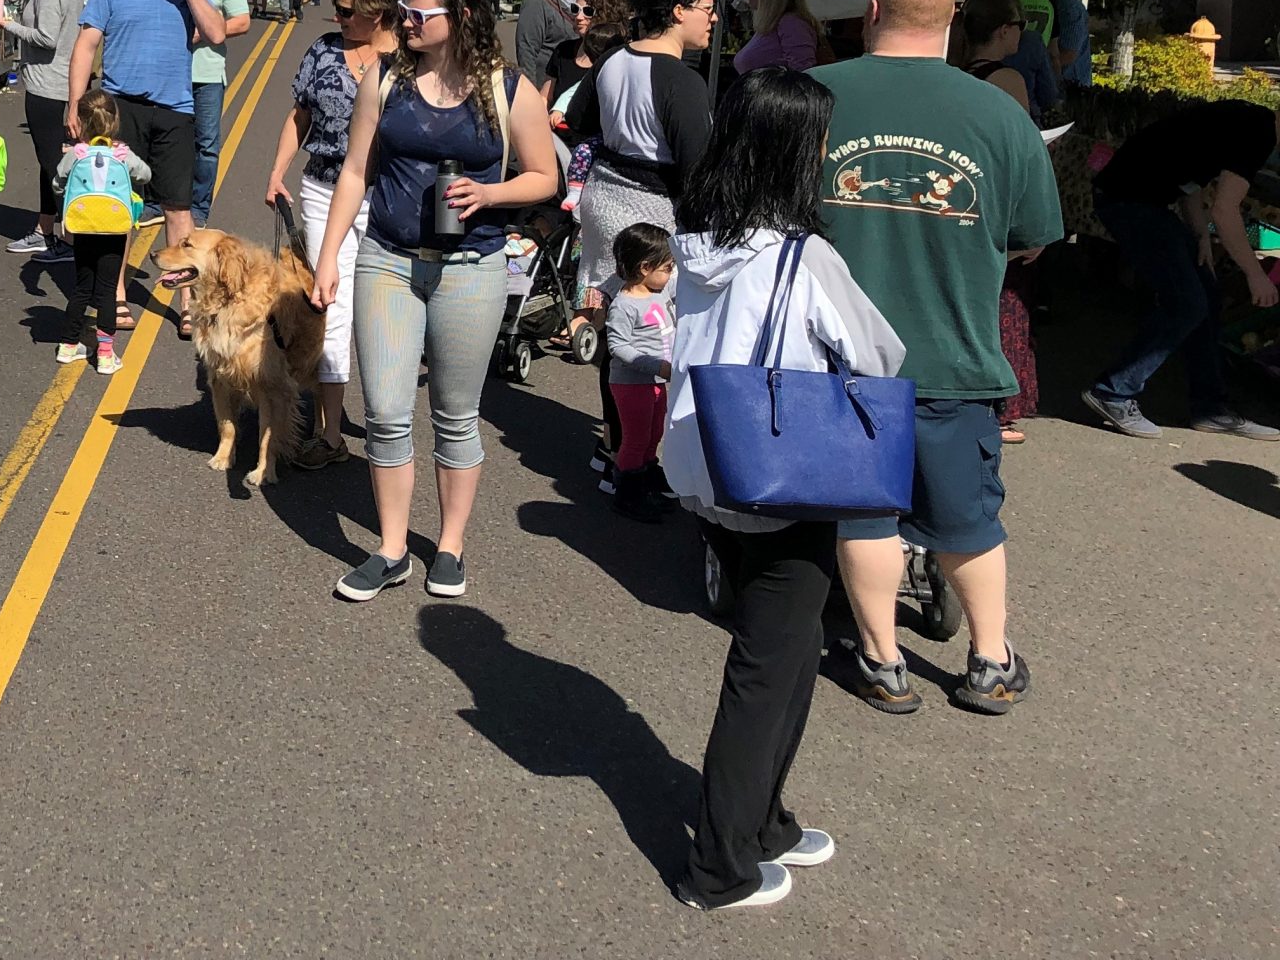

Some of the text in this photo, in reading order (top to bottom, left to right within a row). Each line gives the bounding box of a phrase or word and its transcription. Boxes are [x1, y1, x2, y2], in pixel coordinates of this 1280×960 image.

[828, 134, 984, 180] WHO'S RUNNING NOW?
